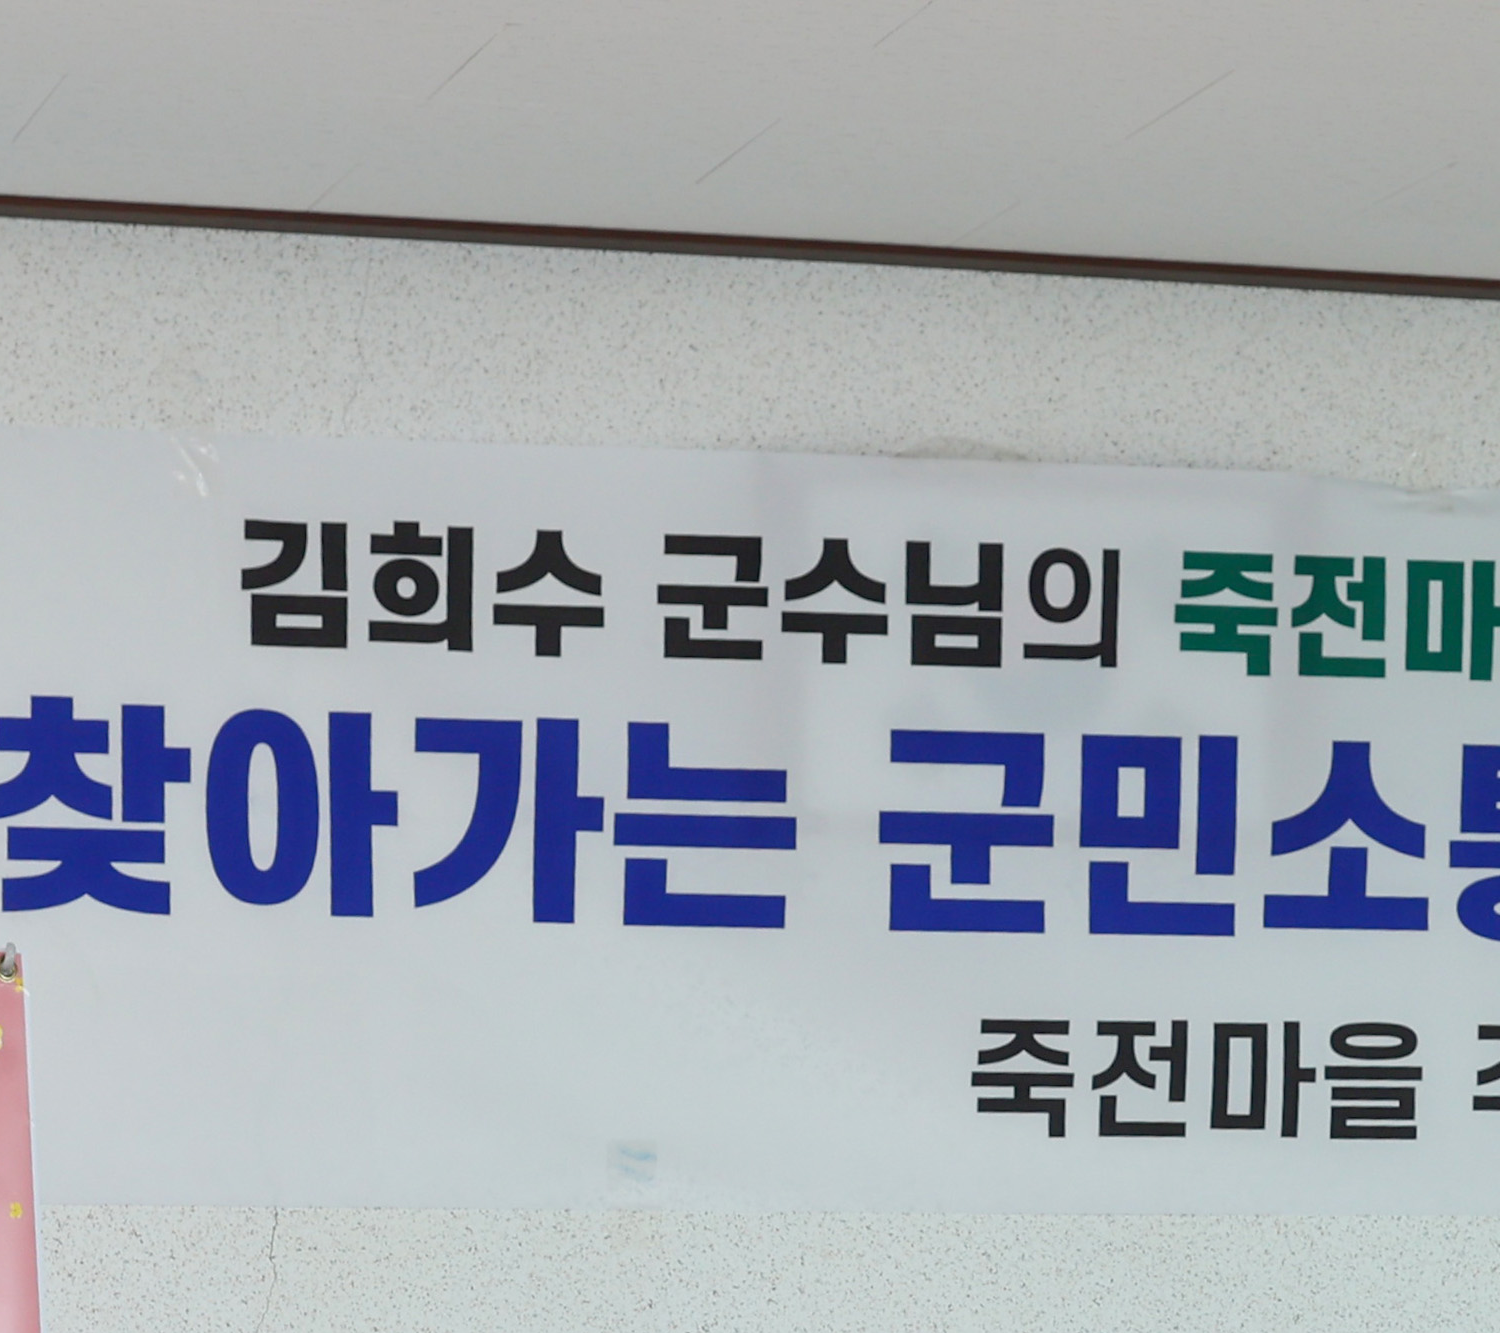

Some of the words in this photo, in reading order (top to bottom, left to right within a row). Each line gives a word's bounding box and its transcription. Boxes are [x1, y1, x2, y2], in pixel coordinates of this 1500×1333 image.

[240, 518, 605, 658] 김희수
[656, 533, 1121, 669] 군수님의
[970, 1018, 1423, 1141] 죽전마을
